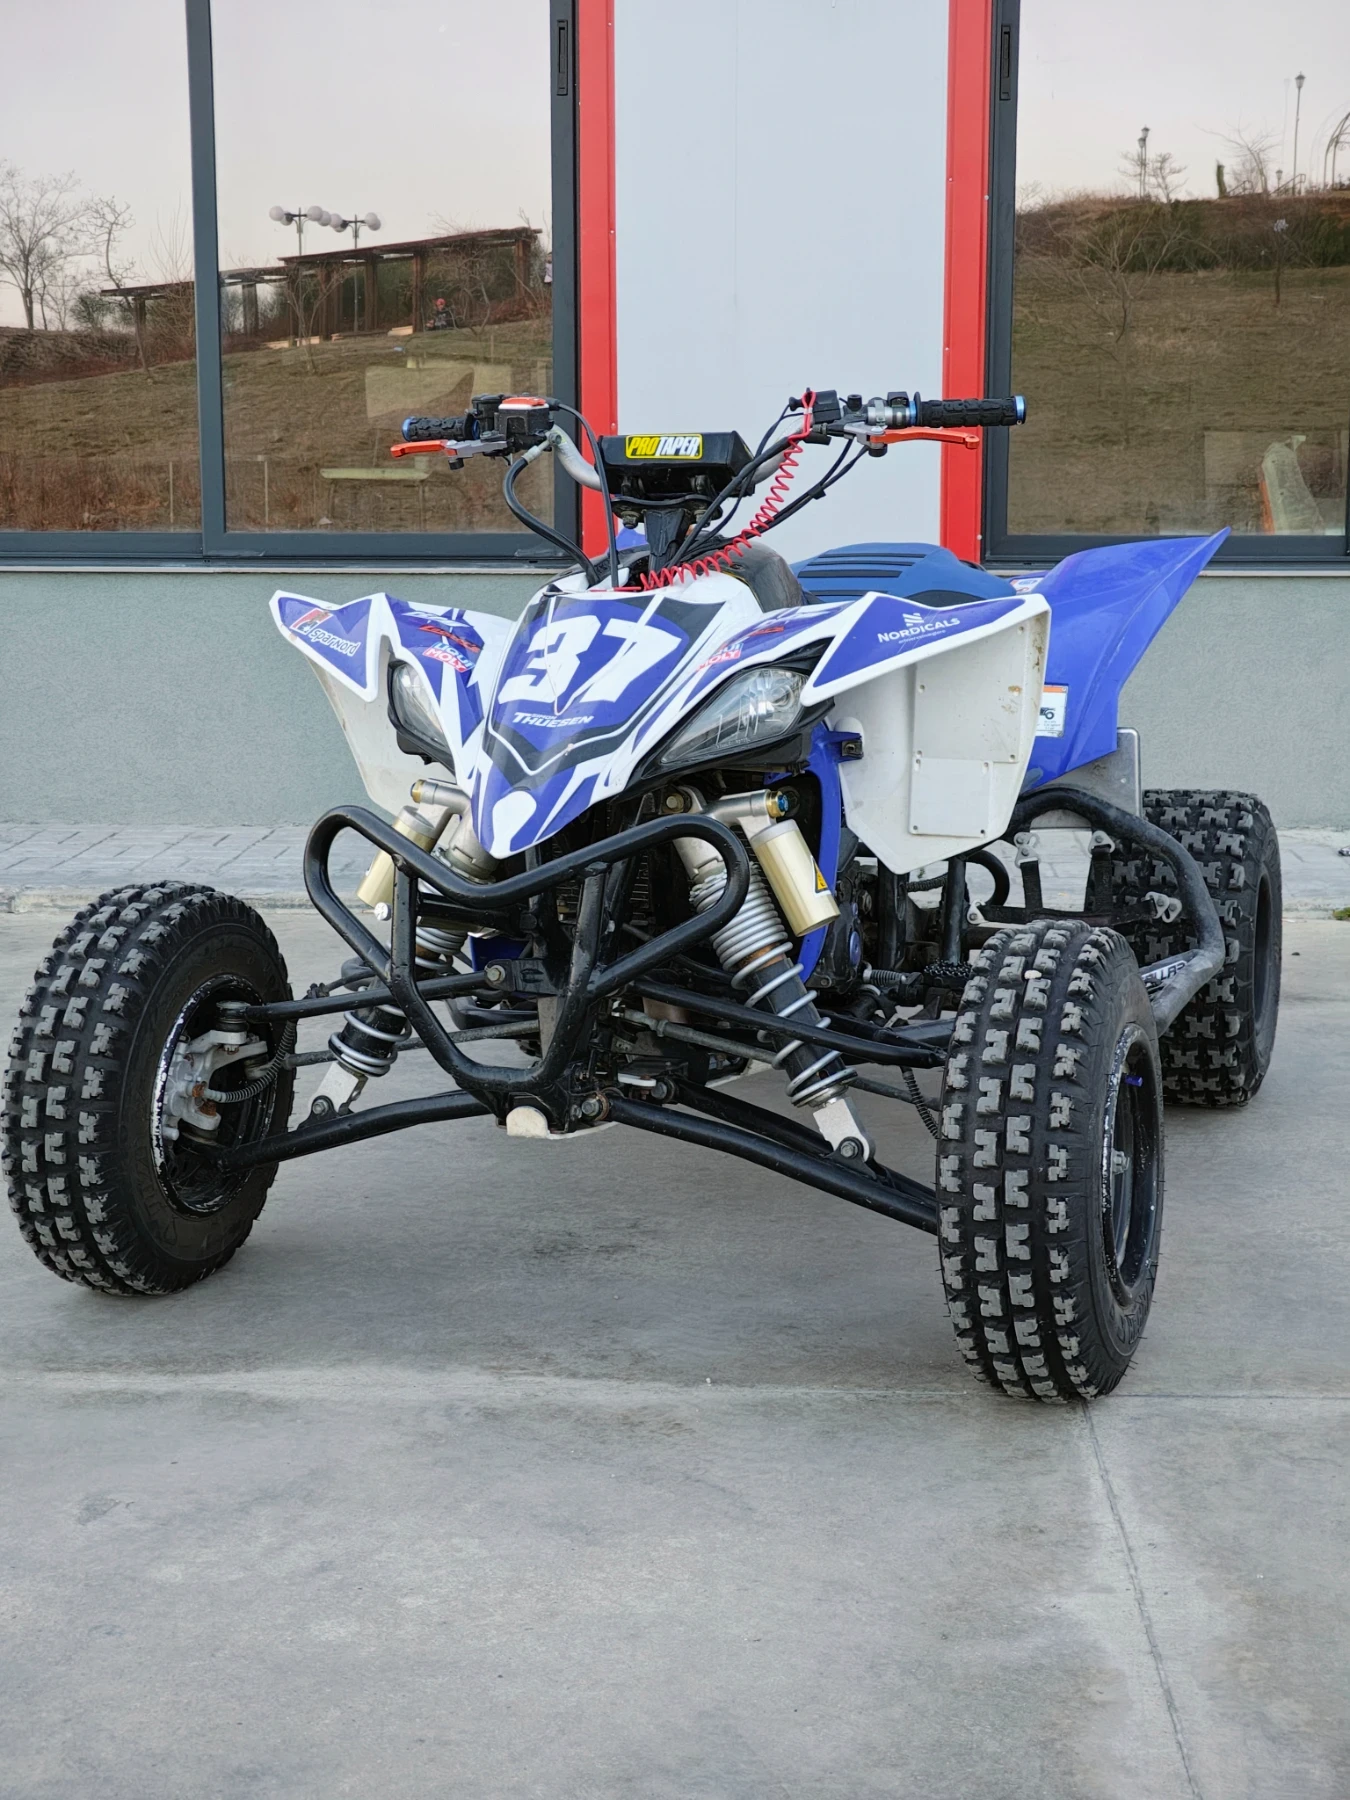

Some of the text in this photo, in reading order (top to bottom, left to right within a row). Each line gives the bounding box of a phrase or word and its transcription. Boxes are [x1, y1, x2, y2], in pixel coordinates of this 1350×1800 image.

[877, 617, 961, 643] NORDICALS
[425, 647, 467, 671] MOLY
[497, 614, 683, 704] 37
[512, 711, 595, 728] THUESEN
